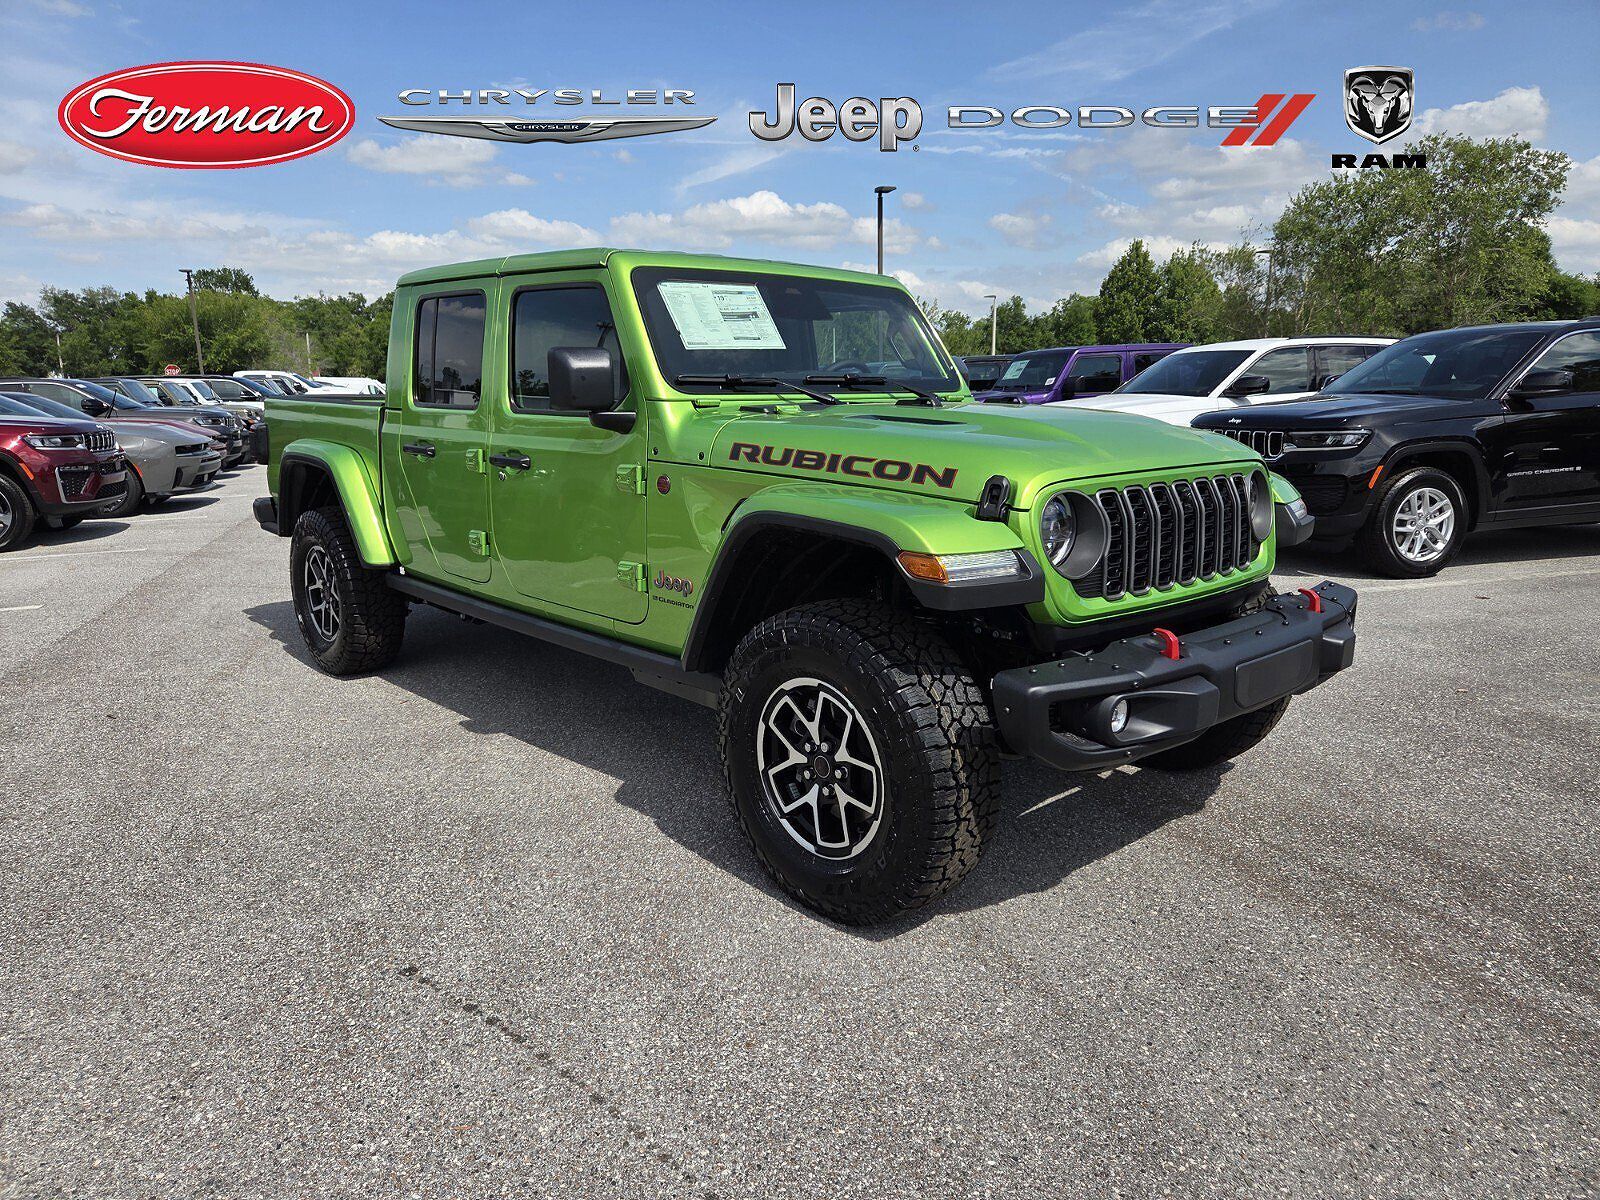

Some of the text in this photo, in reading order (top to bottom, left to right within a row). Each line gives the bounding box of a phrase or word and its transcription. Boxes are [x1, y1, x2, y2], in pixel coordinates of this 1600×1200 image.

[728, 442, 959, 489] RUBICON
[654, 569, 694, 598] Jeep
[658, 596, 694, 609] GLADIATOR
